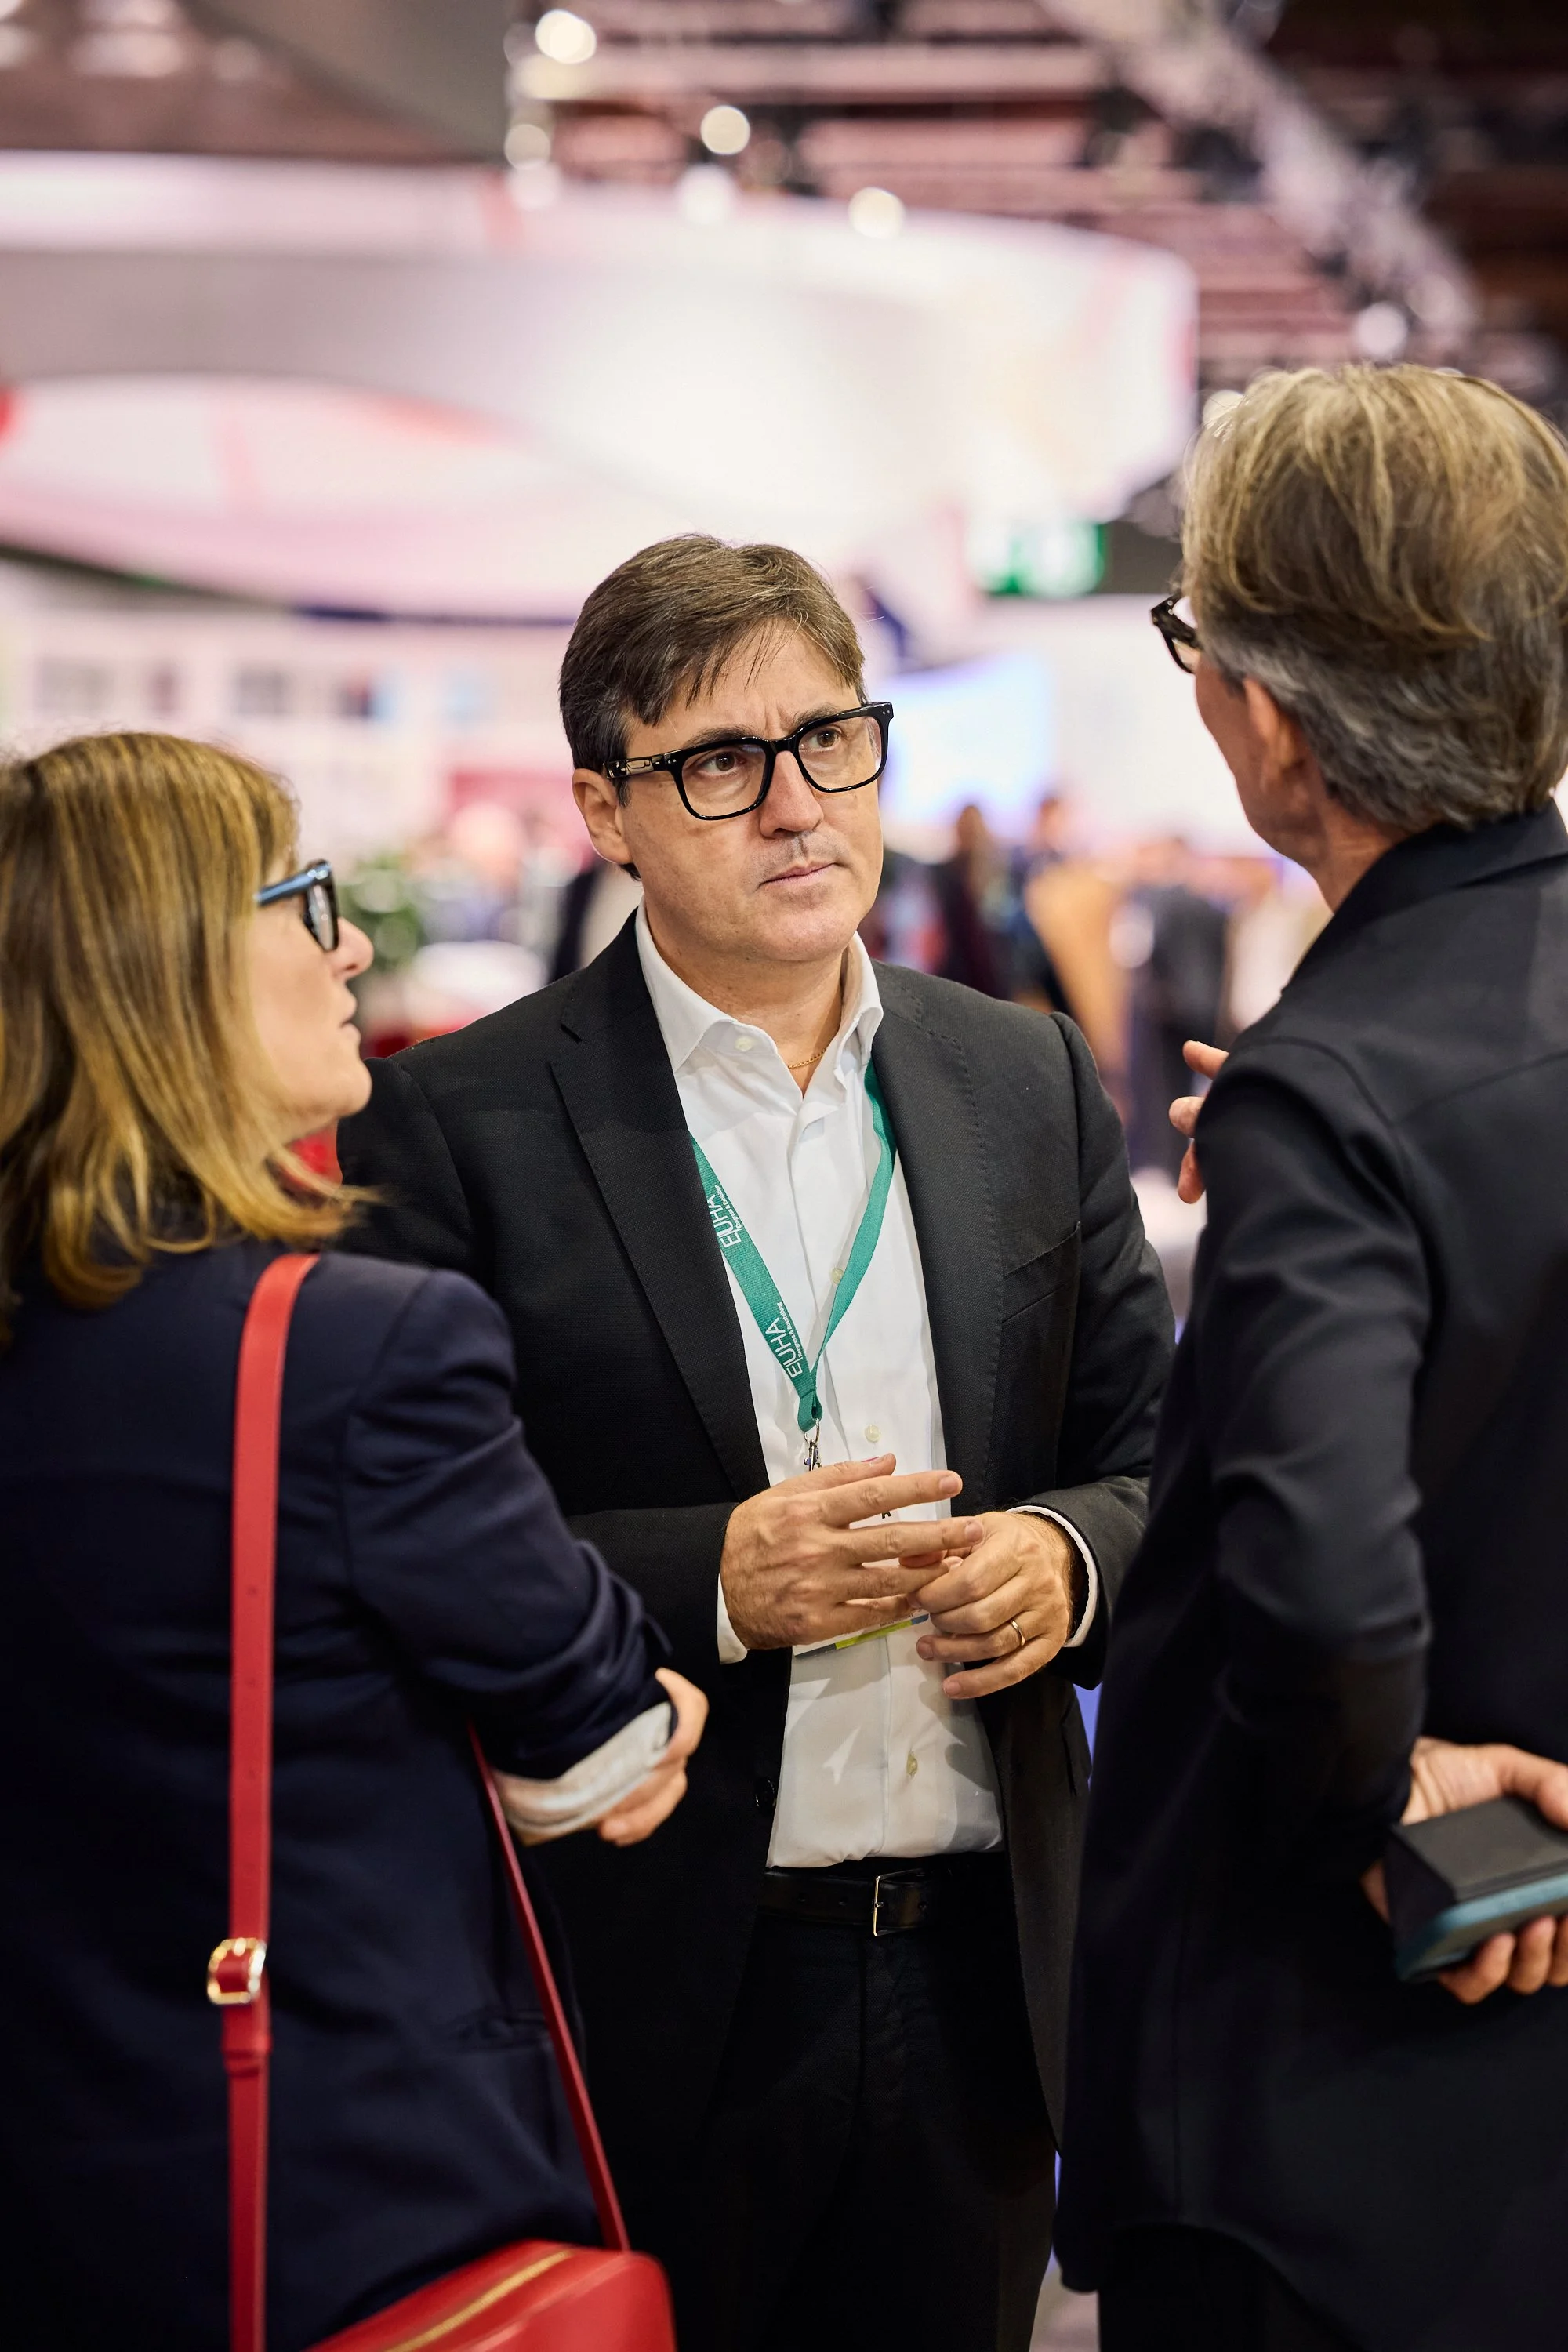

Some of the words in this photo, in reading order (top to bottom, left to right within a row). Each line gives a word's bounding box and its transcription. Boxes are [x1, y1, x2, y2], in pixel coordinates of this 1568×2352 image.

[714, 1184, 728, 1206] Exhibition
[707, 1194, 742, 1247] EUHA
[728, 1208, 742, 1229] Congress
[777, 1301, 792, 1330] Ausstellung
[765, 1317, 803, 1377] EUHA
[791, 1334, 803, 1358] Kongress
